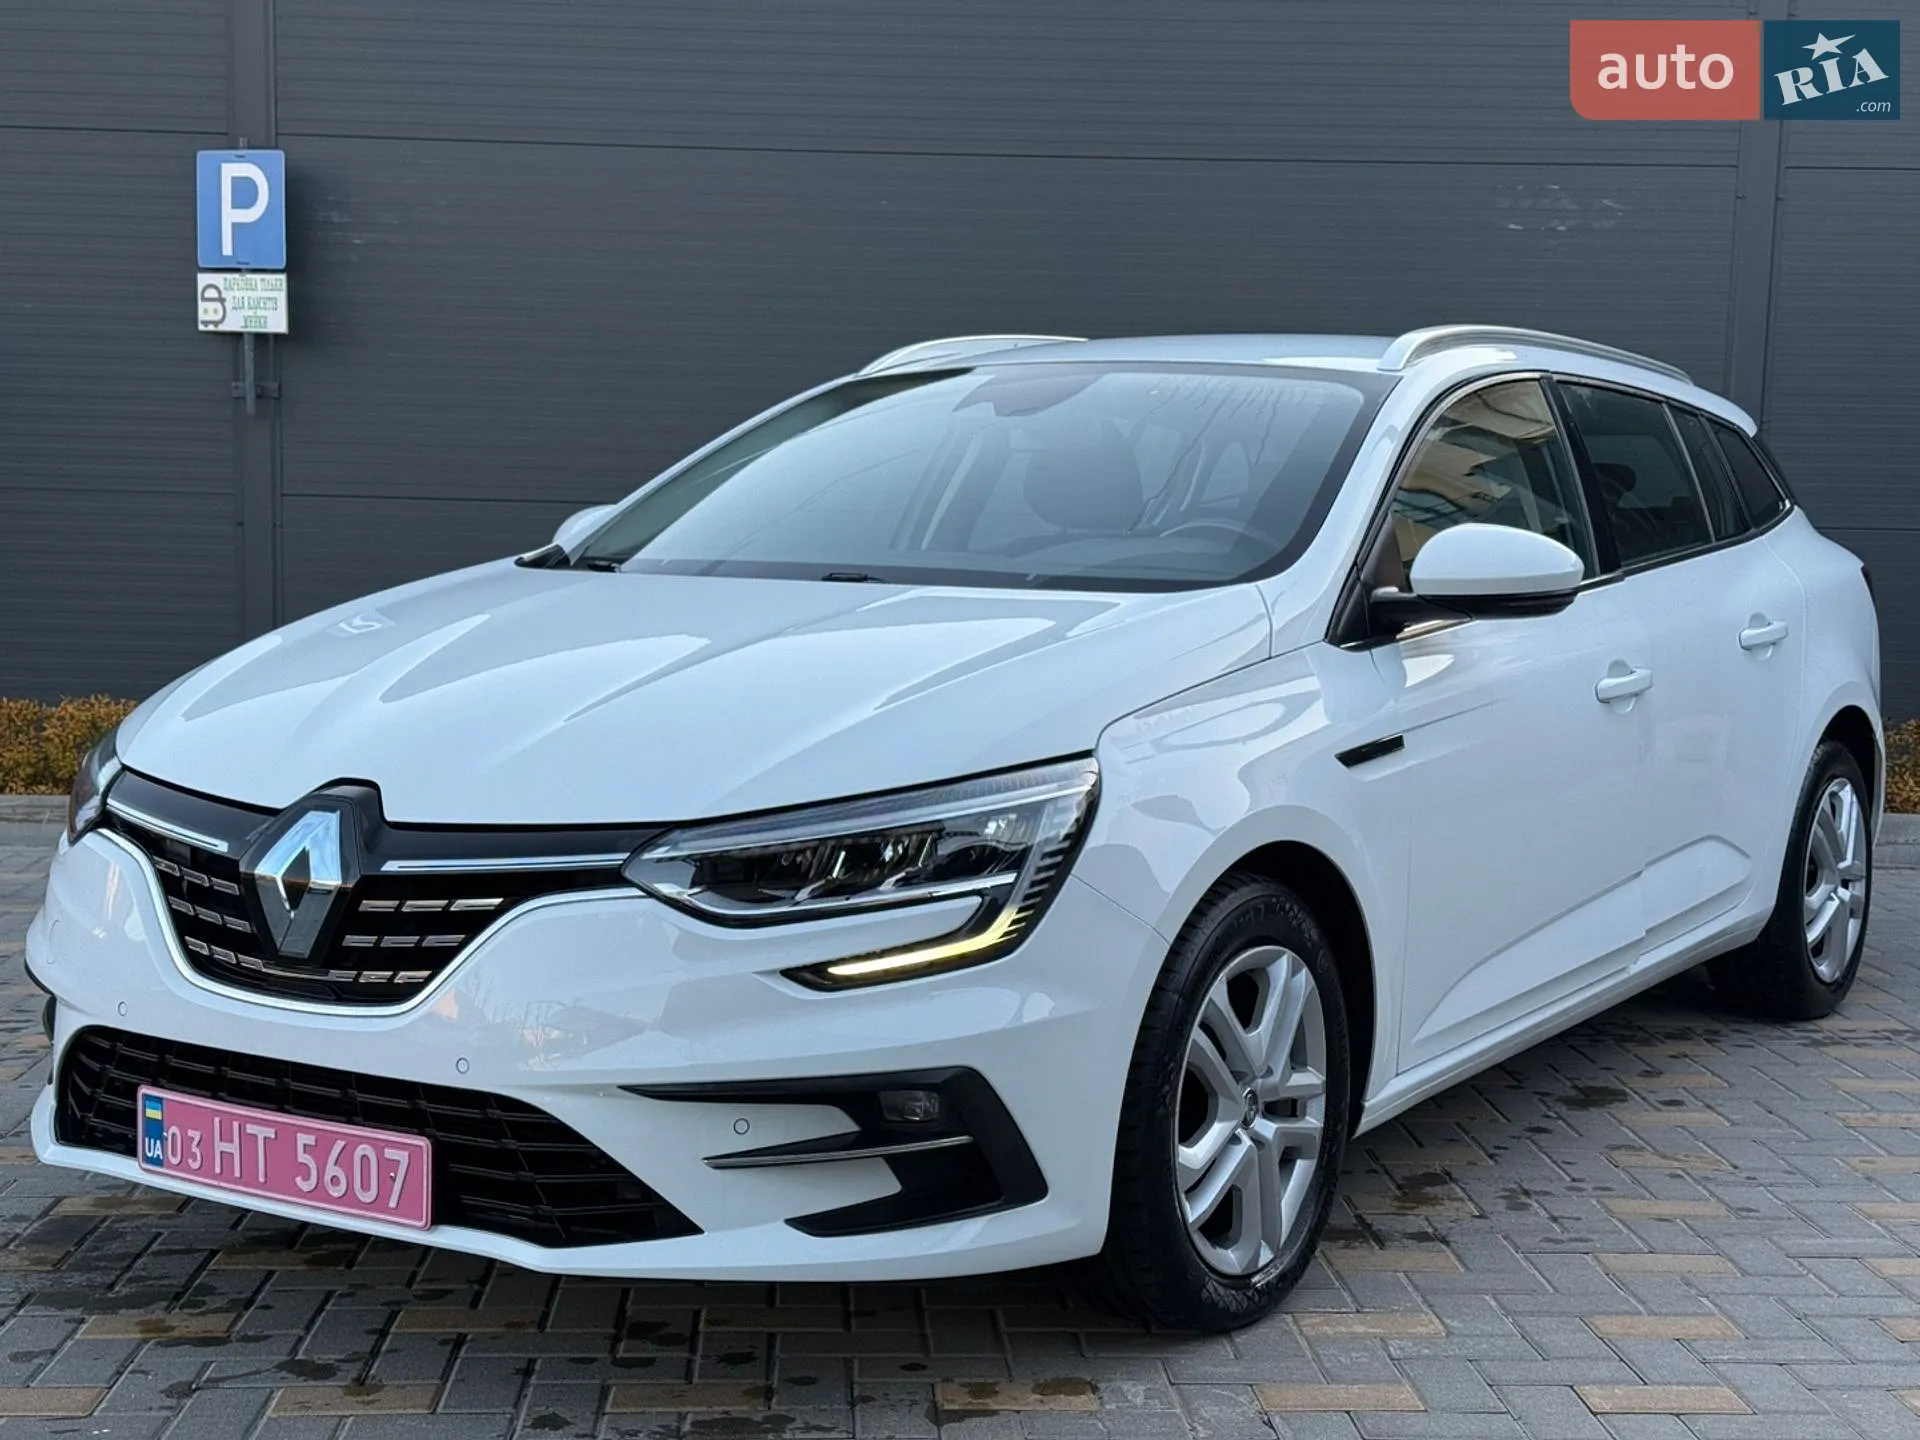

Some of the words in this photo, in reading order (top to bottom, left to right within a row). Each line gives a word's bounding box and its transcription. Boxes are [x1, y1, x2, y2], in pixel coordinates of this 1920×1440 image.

[221, 162, 269, 256] P
[145, 1137, 163, 1160] UA
[167, 1125, 203, 1170] 03
[213, 1117, 277, 1183] HT
[294, 1132, 410, 1209] 5607
